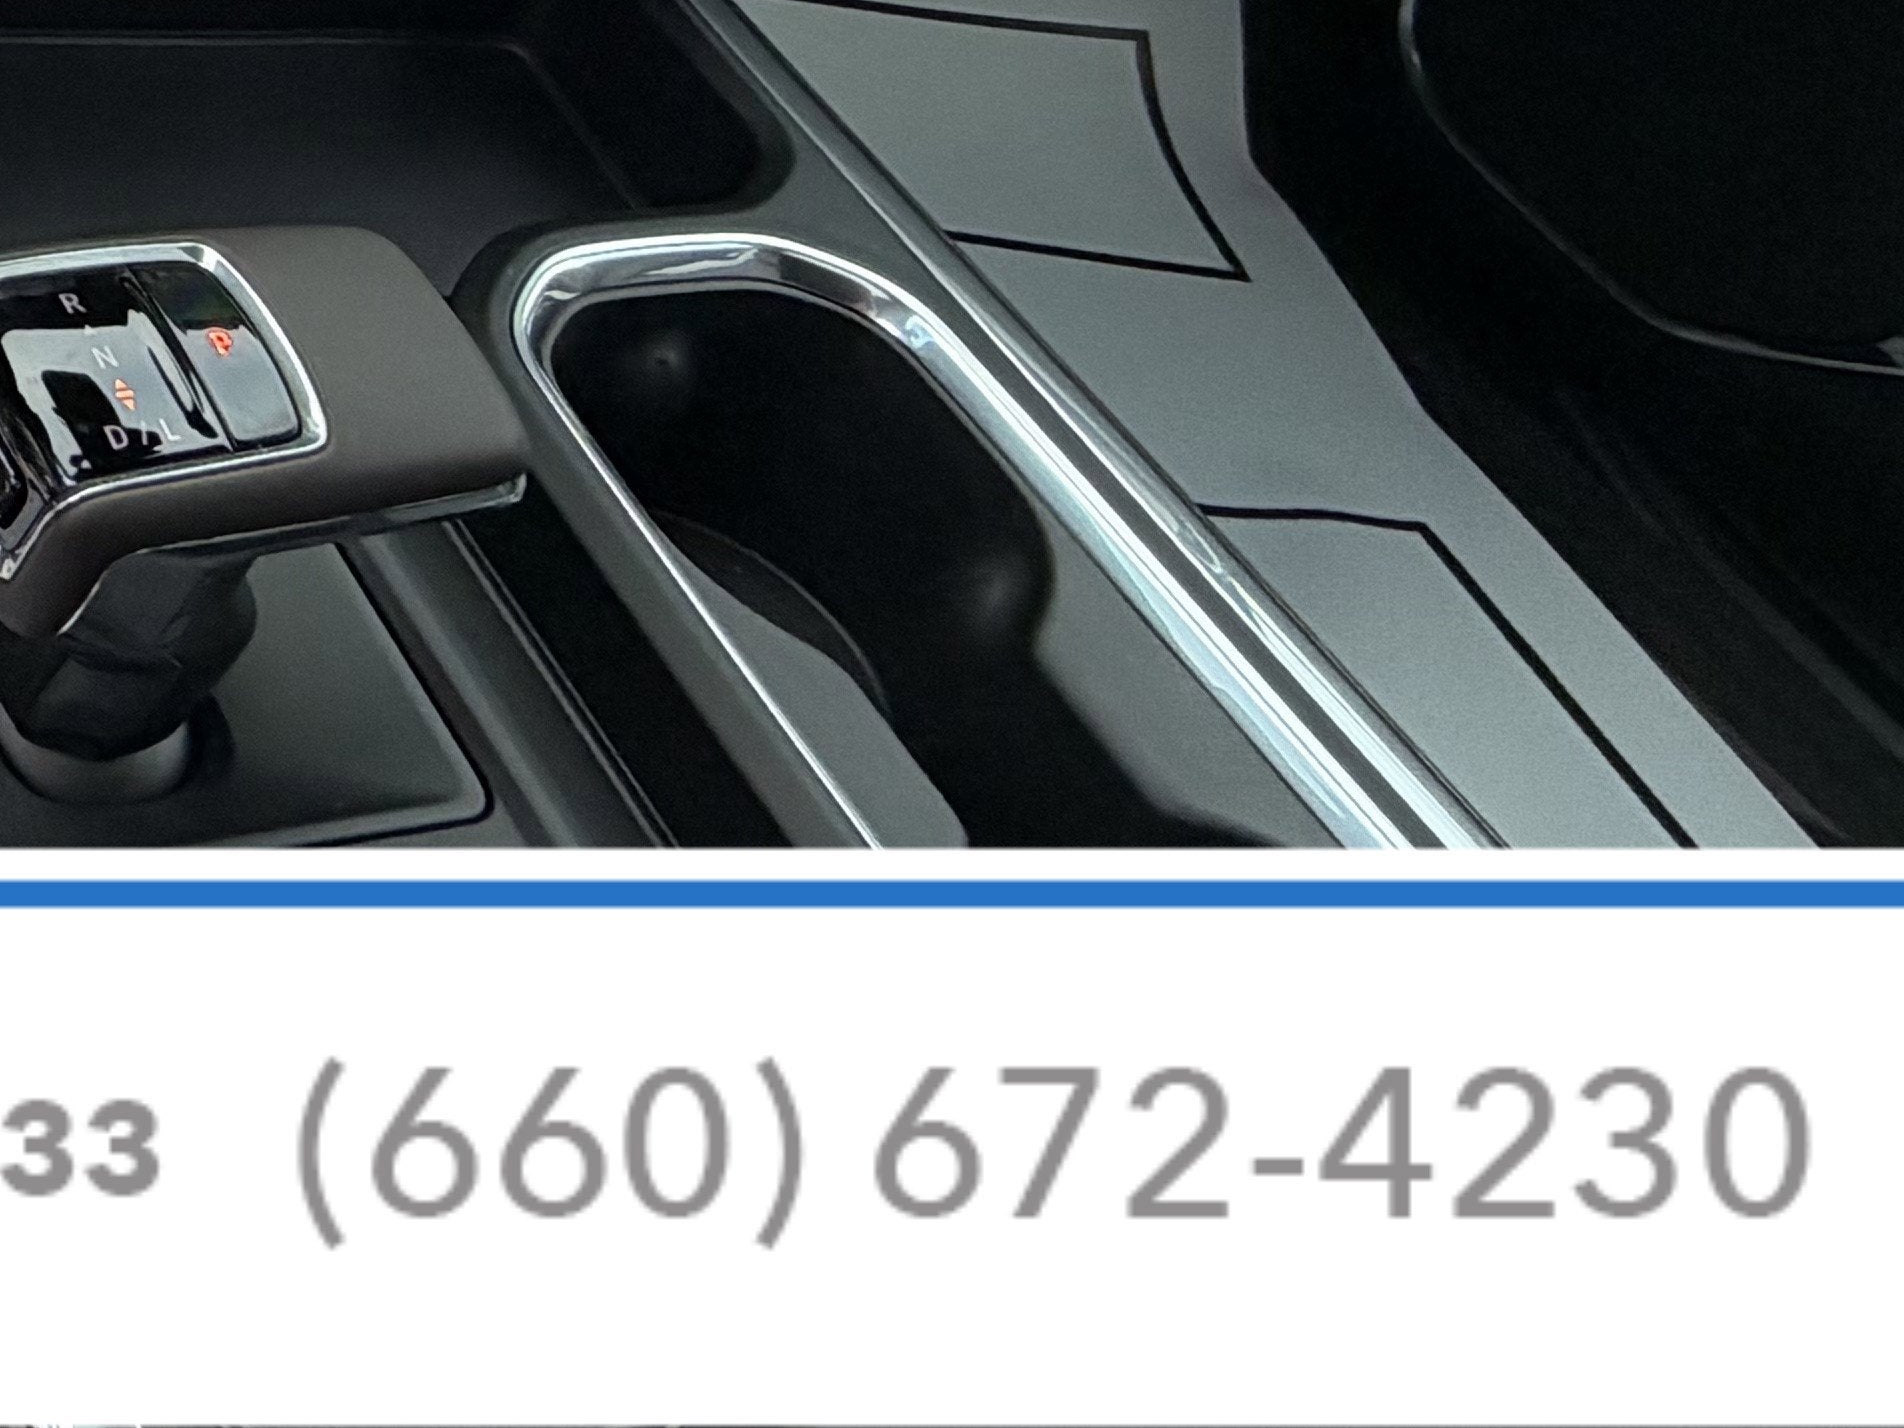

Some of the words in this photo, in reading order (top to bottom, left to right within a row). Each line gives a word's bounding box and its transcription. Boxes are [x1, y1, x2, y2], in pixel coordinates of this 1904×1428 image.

[59, 292, 87, 315] R
[207, 327, 234, 357] P
[92, 346, 120, 370] N
[103, 424, 129, 448] D
